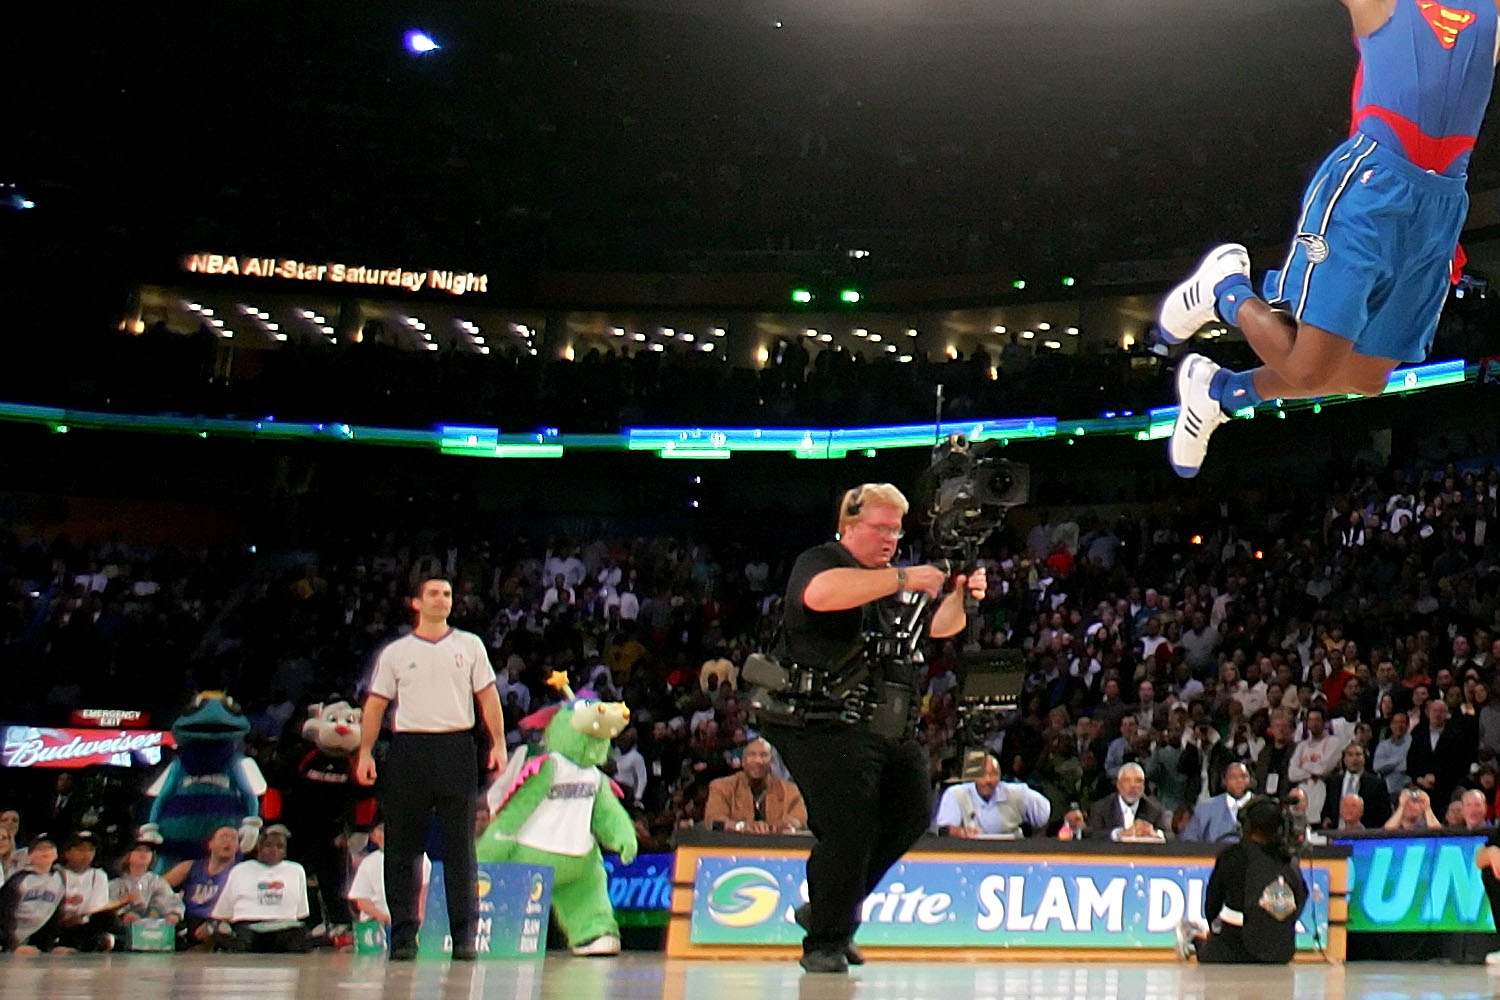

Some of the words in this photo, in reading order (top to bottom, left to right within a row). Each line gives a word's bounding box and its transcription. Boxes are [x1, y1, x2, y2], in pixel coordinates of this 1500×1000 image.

[188, 253, 238, 275] NBA
[241, 256, 326, 281] All-Star
[327, 262, 426, 292] Saturday
[429, 270, 488, 295] Night
[82, 708, 142, 720] EMERGENCY
[99, 718, 122, 727] EXIT
[5, 730, 163, 768] Budweiser
[976, 874, 1127, 933] SLAM
